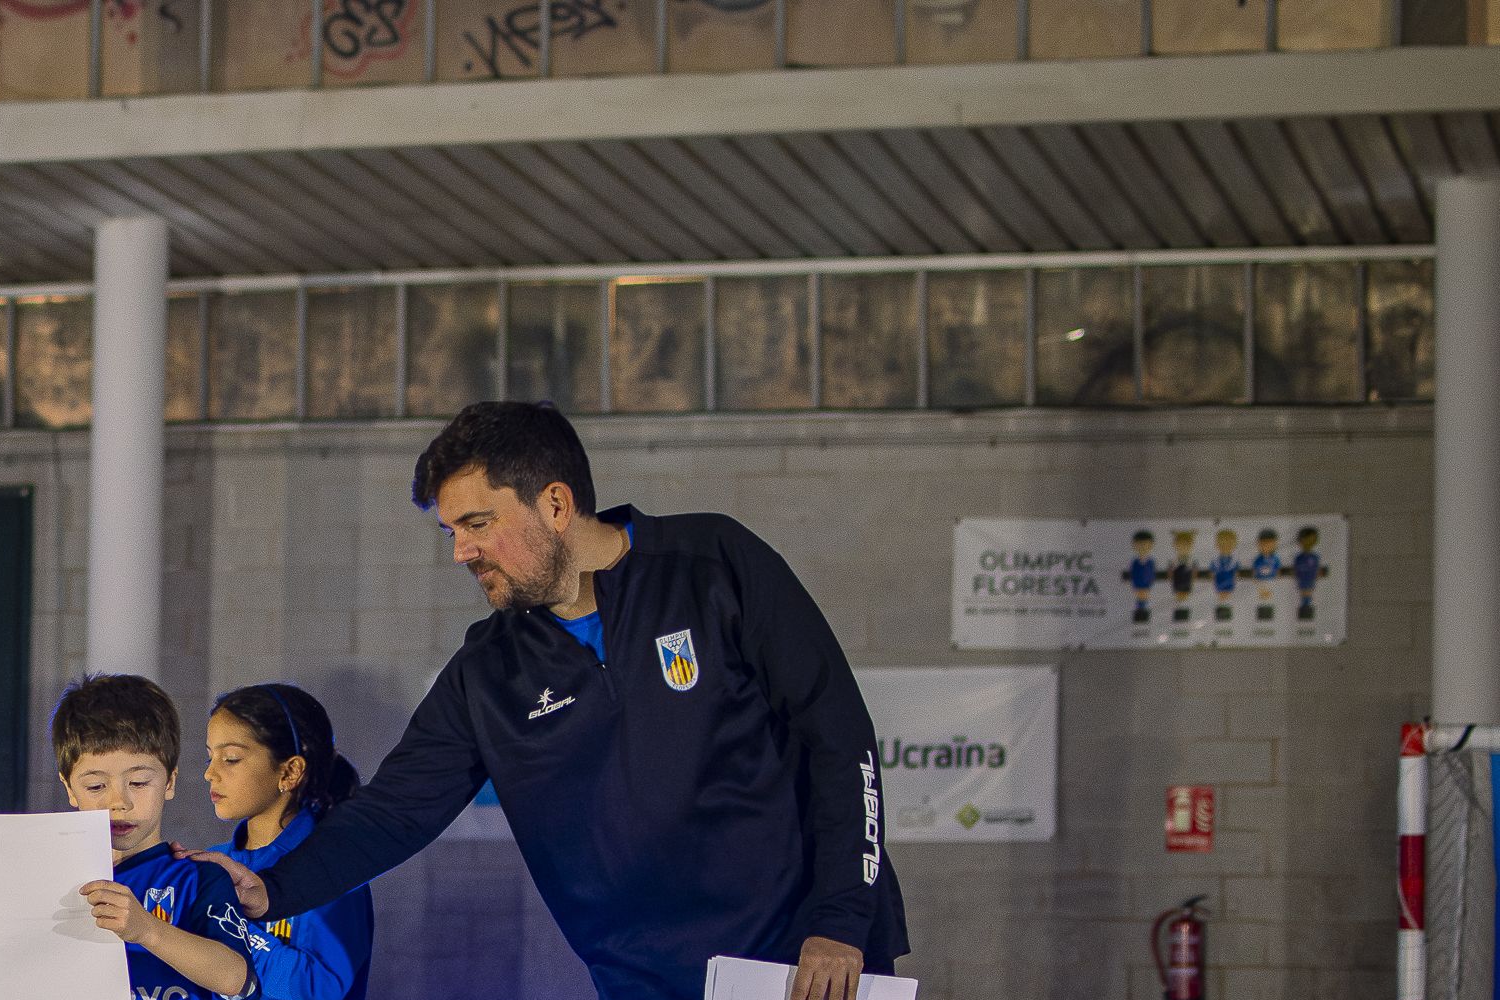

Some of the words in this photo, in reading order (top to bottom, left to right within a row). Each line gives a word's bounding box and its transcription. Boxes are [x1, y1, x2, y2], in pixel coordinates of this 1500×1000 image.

[979, 550, 1093, 572] OLIMPYC
[972, 574, 1100, 595] FLORESTA
[528, 696, 576, 720] GLOBAL
[878, 736, 1007, 769] Ucraïna
[860, 750, 880, 886] GLOBAL
